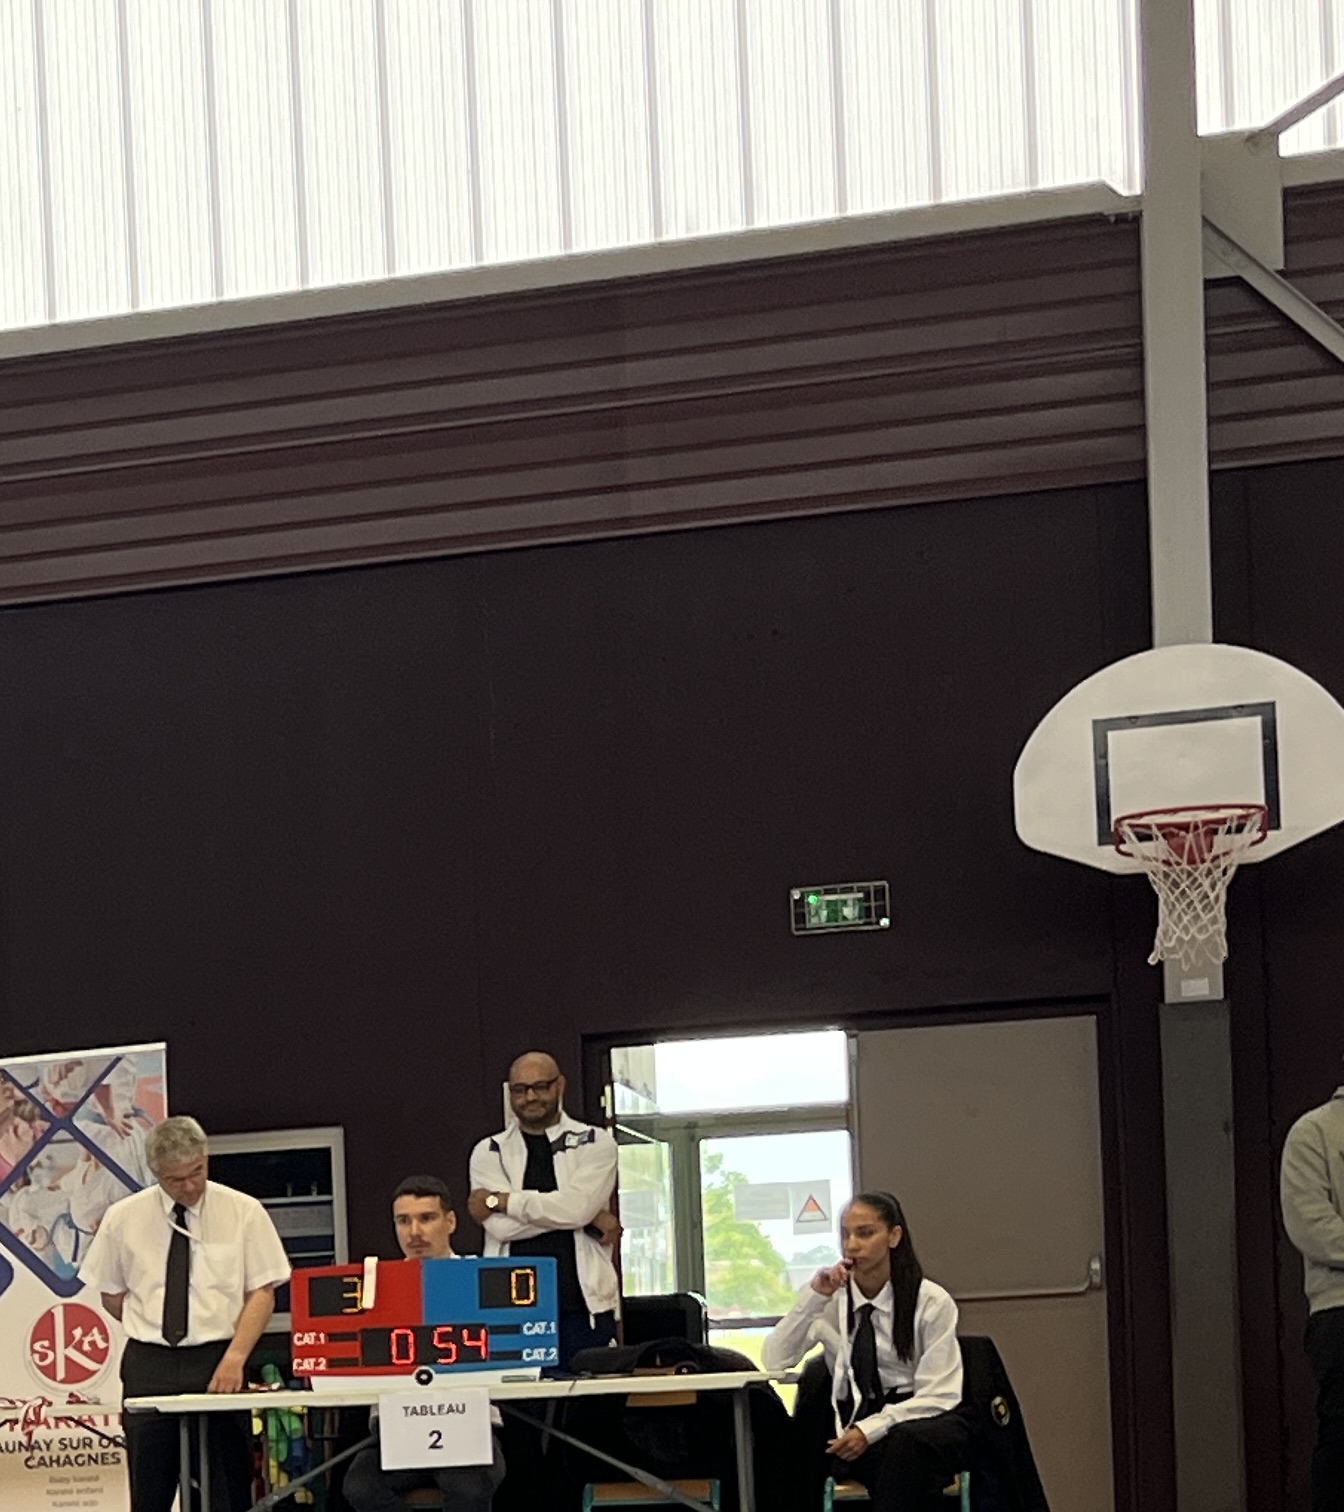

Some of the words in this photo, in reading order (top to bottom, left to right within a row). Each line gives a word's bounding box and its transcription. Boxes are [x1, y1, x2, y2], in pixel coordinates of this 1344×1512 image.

[510, 1268, 536, 1305] 0
[522, 1321, 557, 1335] CAT.1
[522, 1348, 558, 1361] CAT.2
[292, 1357, 327, 1371] CAT.2
[402, 1403, 466, 1417] TABLEAU
[58, 1436, 93, 1451] SUR
[428, 1429, 444, 1450] 2
[23, 1451, 122, 1469] CAHAGNES
